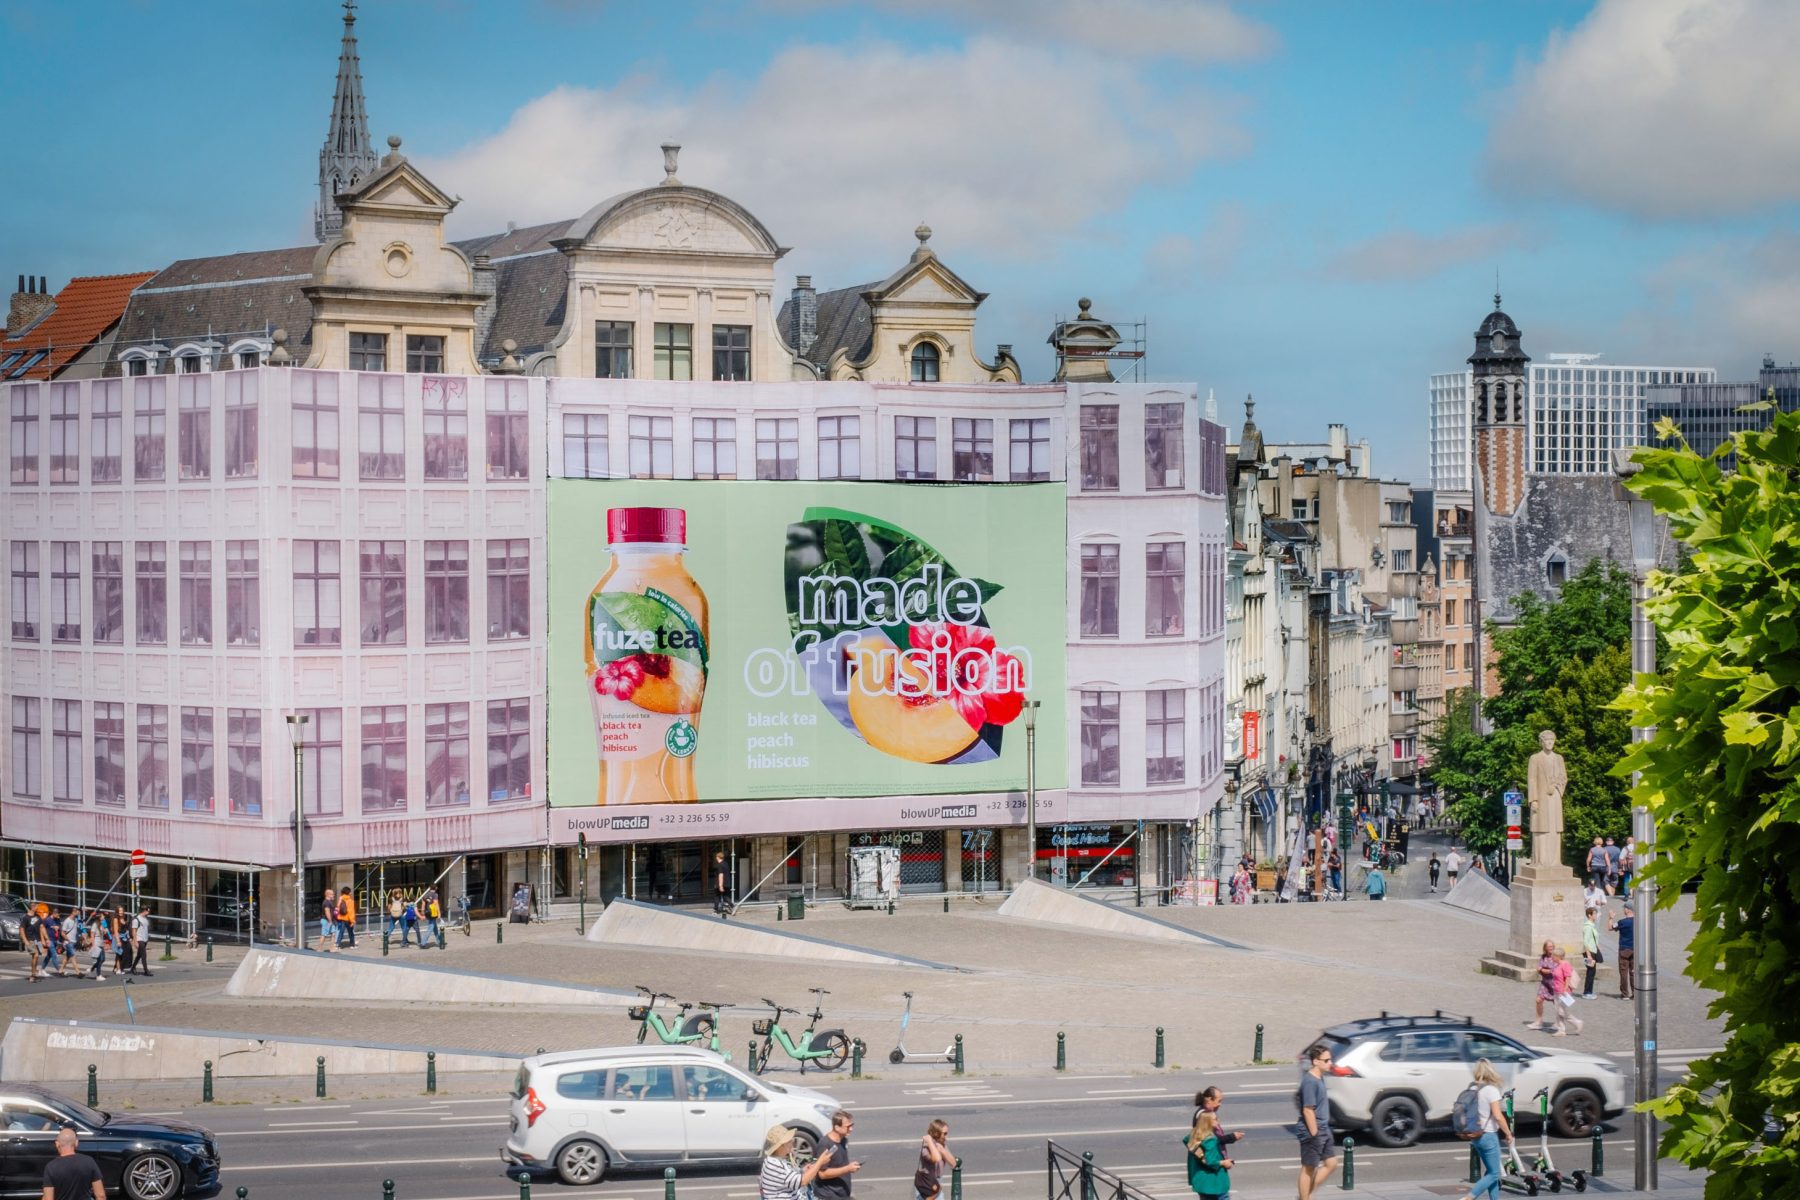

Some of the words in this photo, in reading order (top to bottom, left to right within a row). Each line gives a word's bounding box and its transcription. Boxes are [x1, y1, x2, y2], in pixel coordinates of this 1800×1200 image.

[648, 589, 661, 600] low
[799, 564, 982, 626] made
[593, 622, 700, 650] fuzetea
[743, 630, 820, 697] of
[827, 630, 1033, 696] fusion
[602, 722, 626, 730] black
[747, 711, 789, 727] black
[793, 713, 817, 726] tea
[603, 733, 629, 742] peach
[747, 731, 793, 751] peach
[603, 744, 638, 752] hibiscus
[747, 754, 810, 770] hibiscus
[987, 802, 1001, 810] +32
[1012, 800, 1027, 808] 236
[1043, 800, 1053, 808] 59
[659, 815, 674, 824] +32
[678, 814, 684, 823] 3
[686, 814, 702, 823] 236
[705, 813, 716, 822] 55
[719, 813, 730, 822] 59
[962, 830, 993, 850] 7/7
[360, 886, 424, 909] ENYMA
